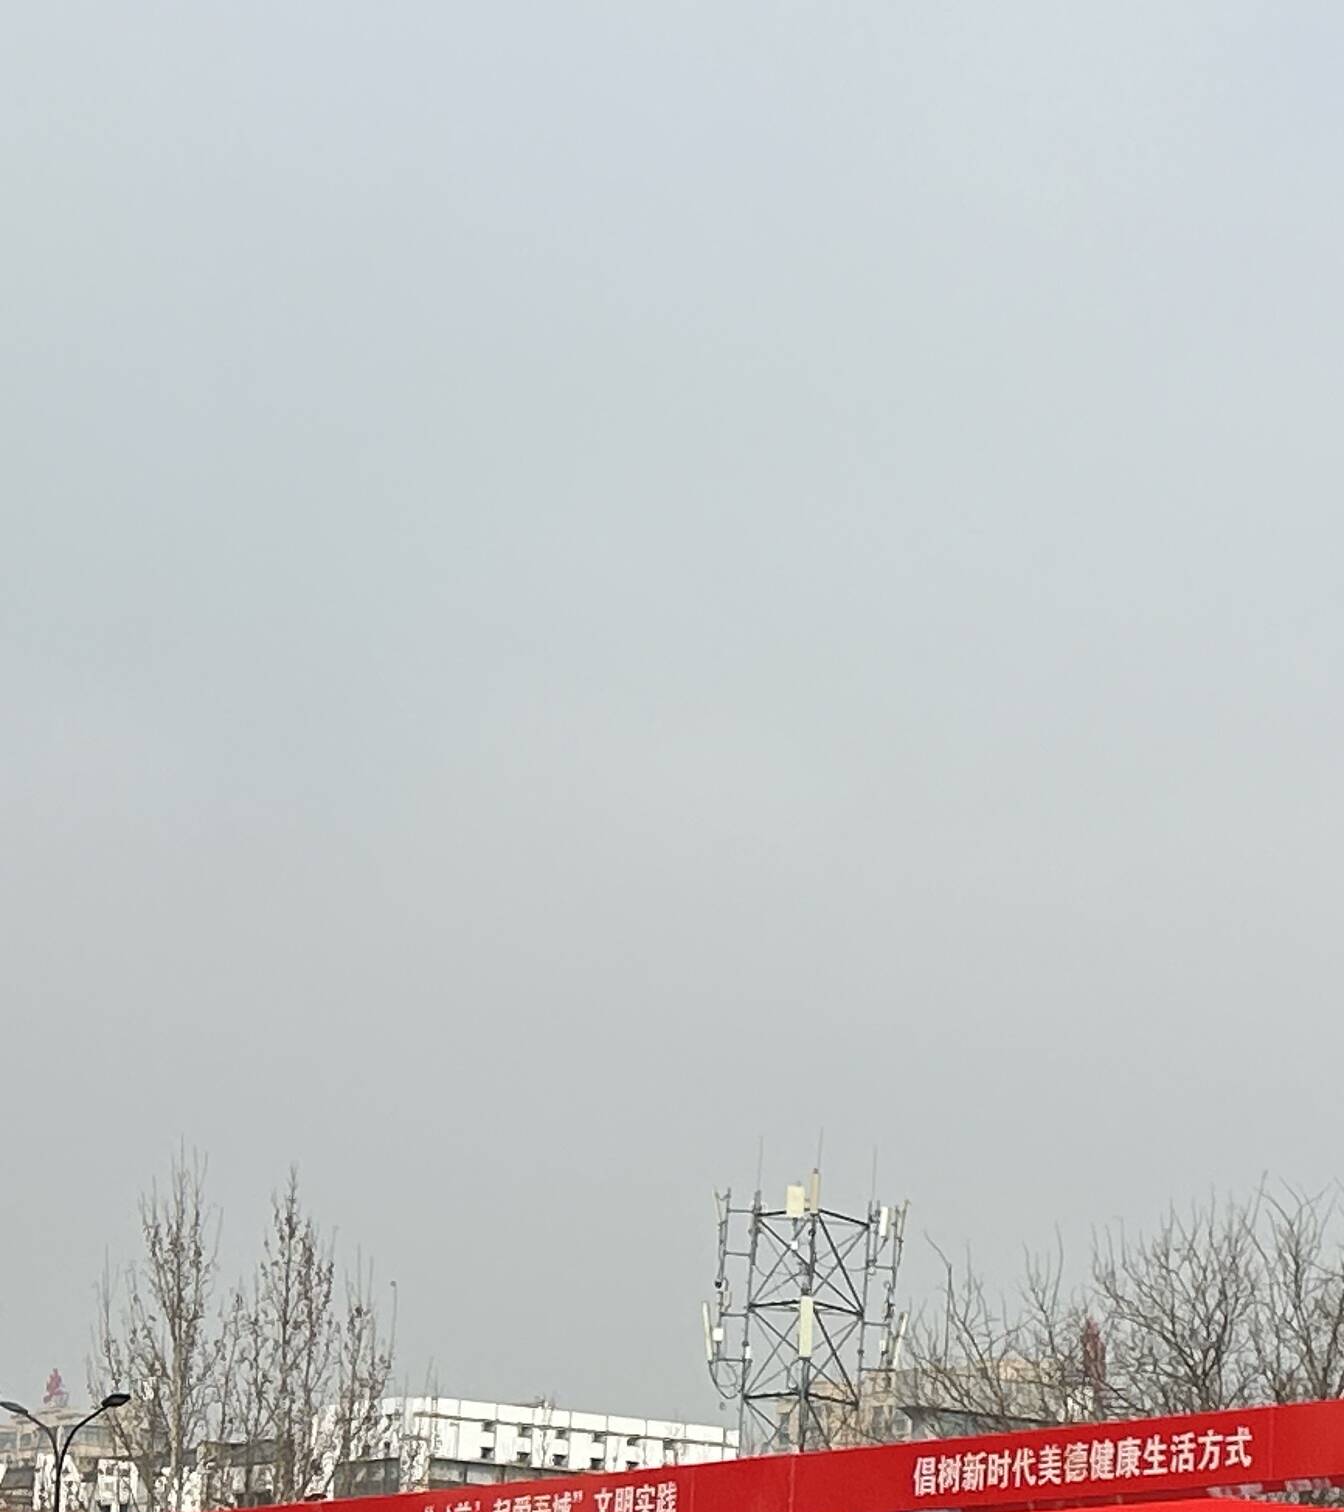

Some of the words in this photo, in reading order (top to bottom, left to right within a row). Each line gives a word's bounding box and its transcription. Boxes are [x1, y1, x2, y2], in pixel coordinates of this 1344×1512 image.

[912, 1426, 1253, 1497] 倡树新时代美德健康生活方式
